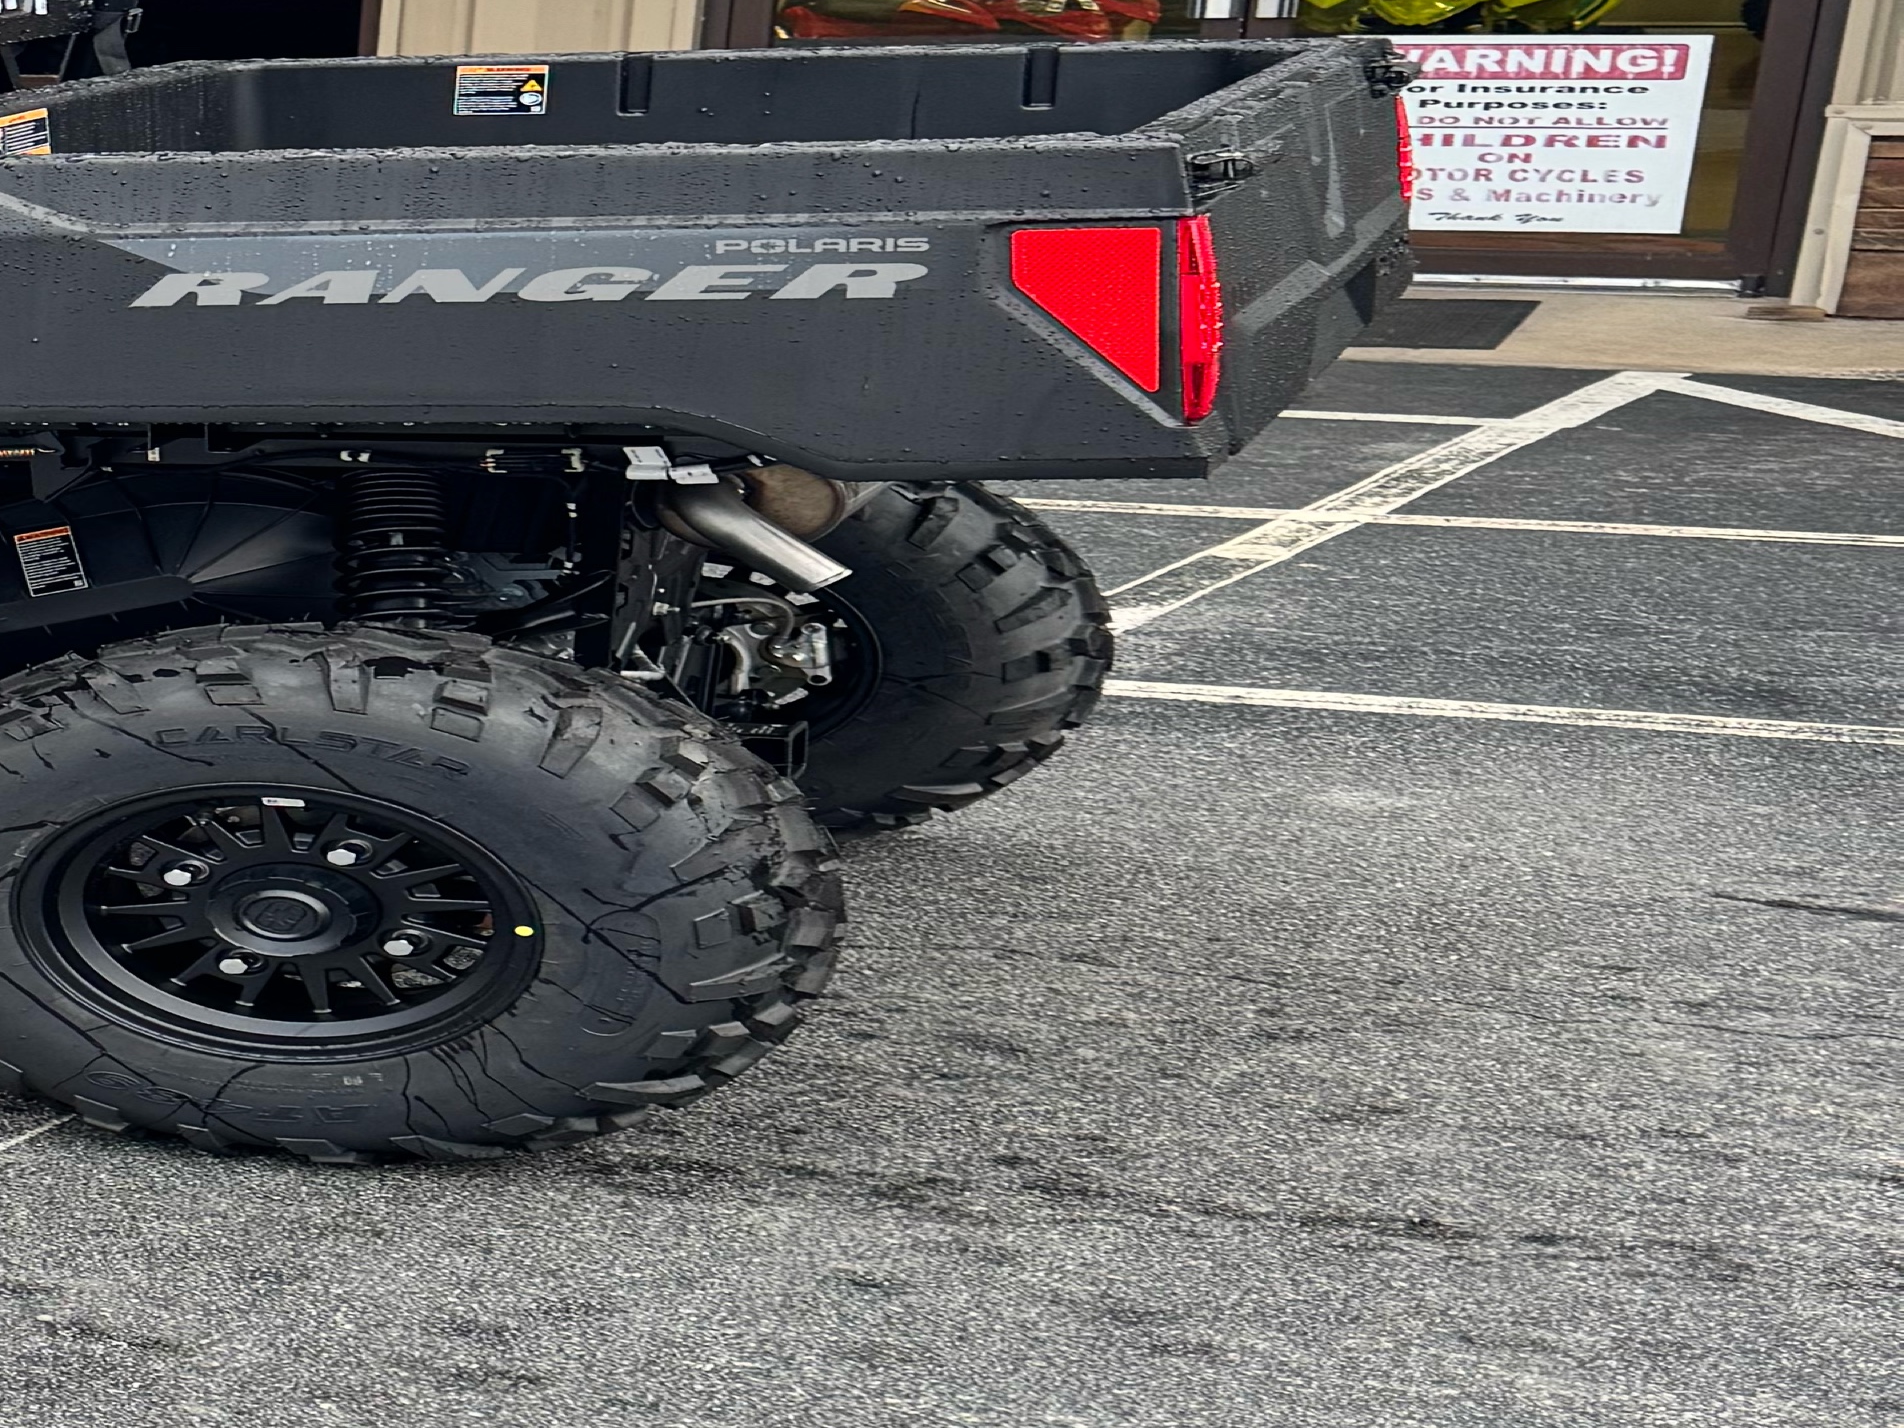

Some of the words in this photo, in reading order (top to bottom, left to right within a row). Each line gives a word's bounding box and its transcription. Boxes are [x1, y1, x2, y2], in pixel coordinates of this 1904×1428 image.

[1406, 84, 1444, 94] or
[1457, 83, 1650, 94] Insurance
[1418, 99, 1608, 111] Purposes:
[1417, 116, 1460, 125] DO
[1473, 116, 1542, 126] NOT
[1552, 117, 1669, 127] ALLOW
[1477, 152, 1533, 164] ON
[1411, 168, 1494, 182] OTOR
[1508, 169, 1645, 183] CYCLES
[1450, 189, 1470, 202] &
[1487, 188, 1663, 207] Machinery
[1427, 212, 1502, 222] Thank
[1514, 213, 1565, 224] You
[715, 237, 930, 254] POLARIS
[129, 262, 930, 308] RANGER
